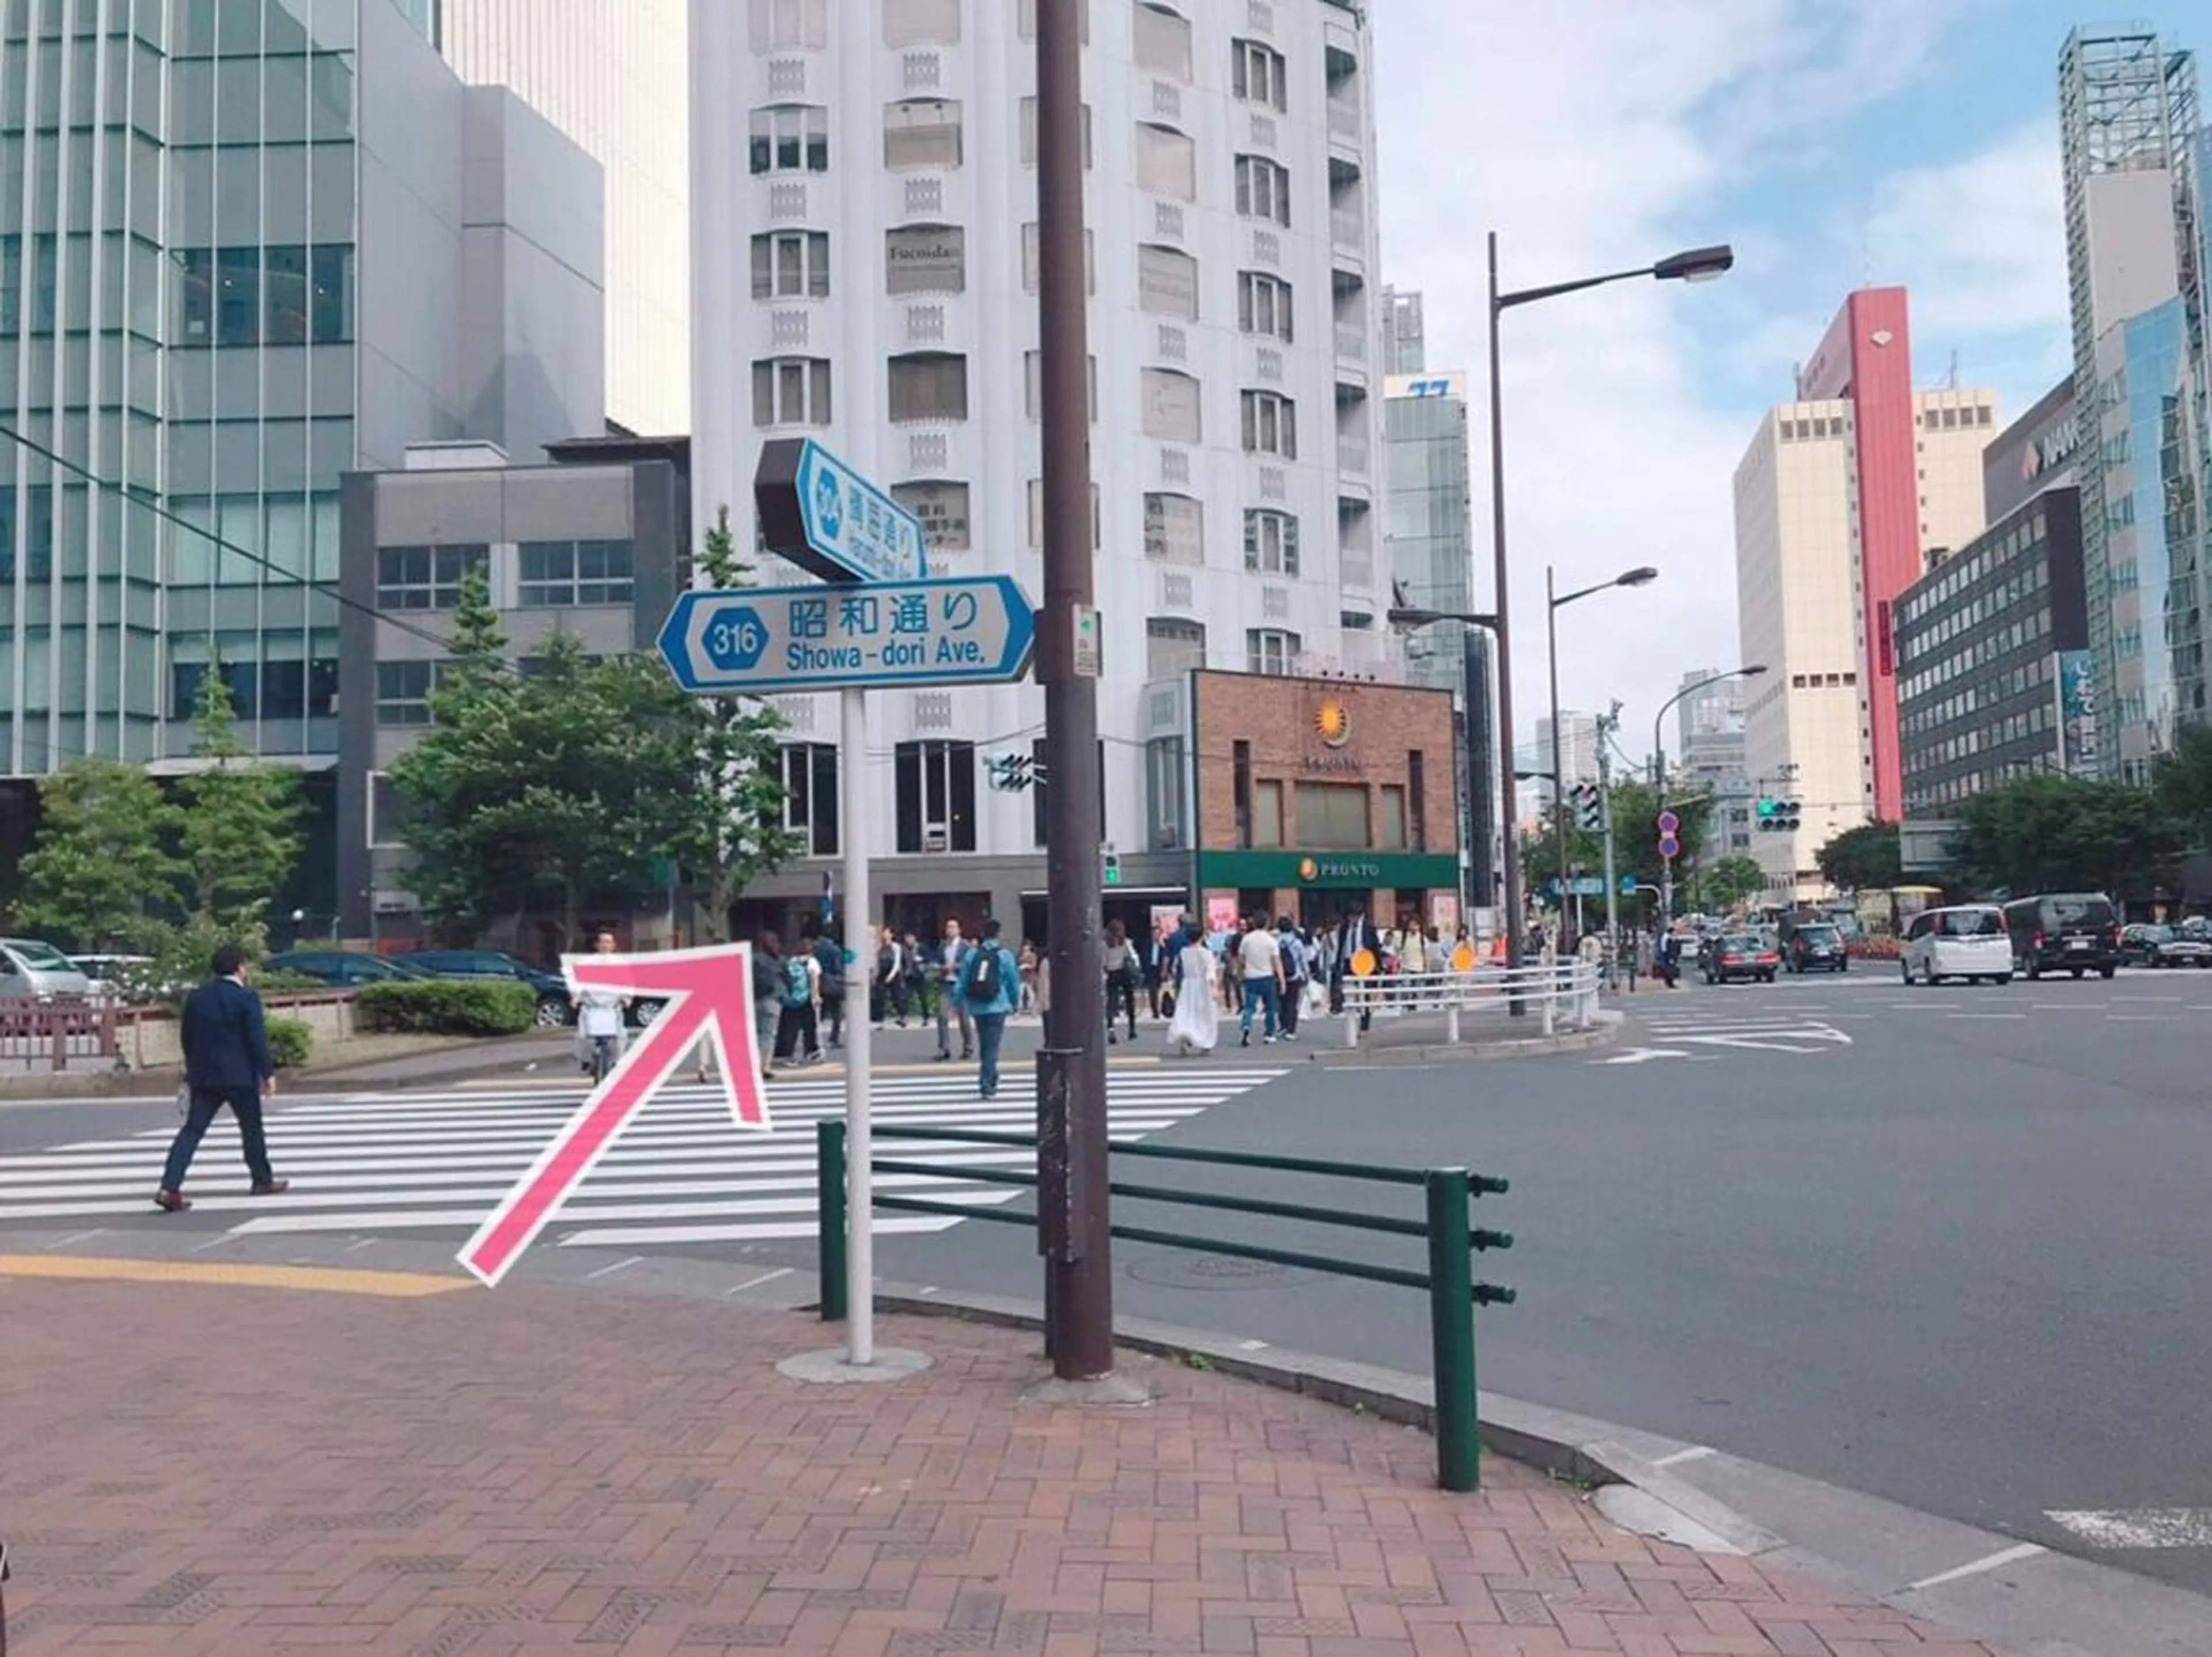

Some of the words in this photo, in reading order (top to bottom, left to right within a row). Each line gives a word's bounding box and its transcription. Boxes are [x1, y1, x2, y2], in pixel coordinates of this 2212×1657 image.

[789, 591, 978, 638] 昭和通り
[713, 623, 757, 655] 316
[786, 638, 926, 670] Showa-dori
[935, 636, 985, 663] Ave.
[1320, 863, 1380, 876] PRONTO
